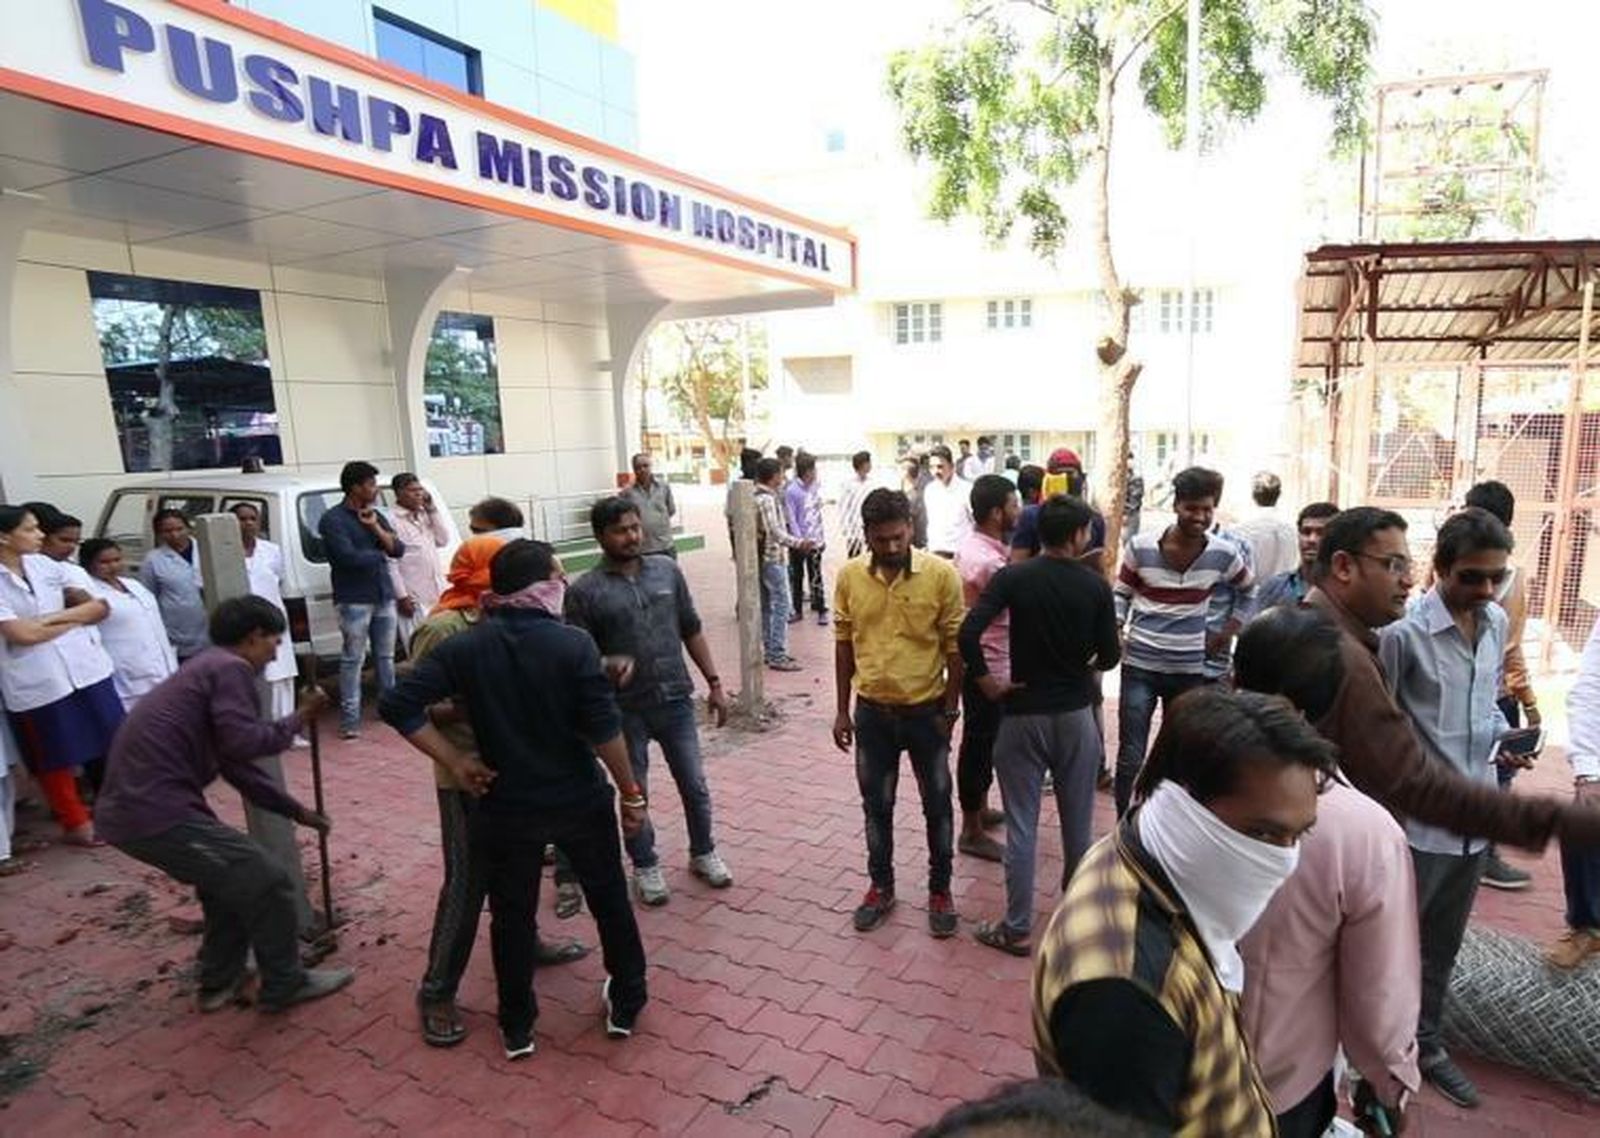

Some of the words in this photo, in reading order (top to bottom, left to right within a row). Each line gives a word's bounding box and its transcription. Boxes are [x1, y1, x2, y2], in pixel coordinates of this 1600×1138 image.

[78, 0, 459, 171] PUSHPA
[475, 130, 682, 232] MISSION
[692, 200, 832, 273] HOSPITAL
